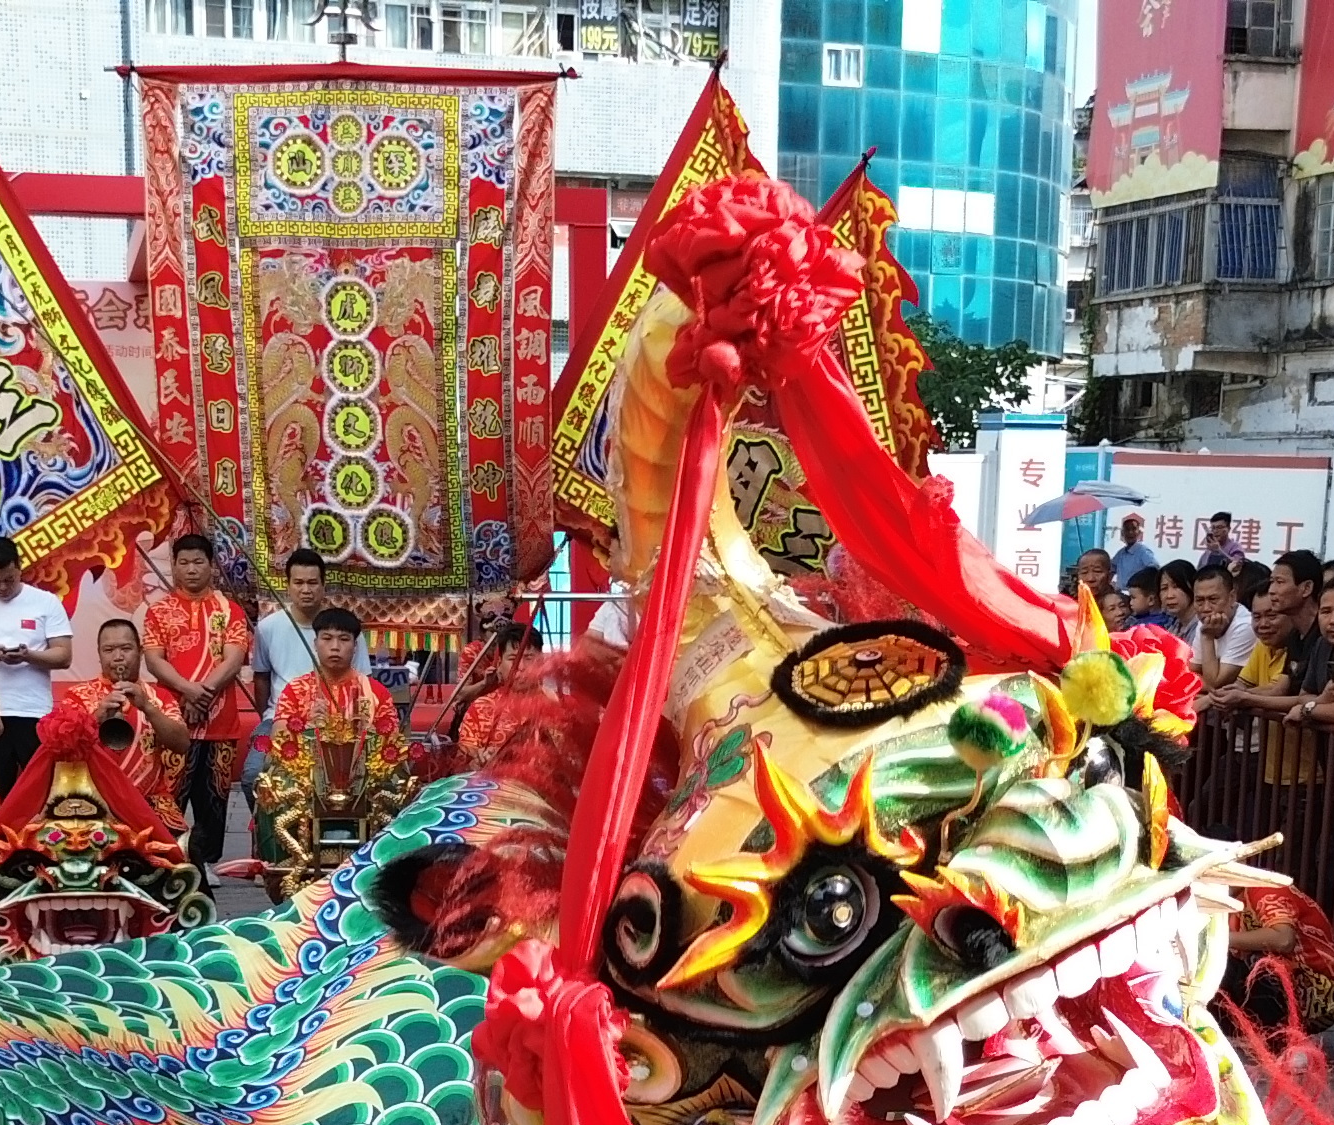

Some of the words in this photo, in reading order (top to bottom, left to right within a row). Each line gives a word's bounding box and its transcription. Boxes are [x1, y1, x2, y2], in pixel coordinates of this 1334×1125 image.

[581, 26, 618, 51] 199元
[684, 31, 719, 57] 79元
[155, 284, 194, 446] 國泰民安
[515, 285, 550, 451] 風調雨順
[1154, 514, 1304, 555] 特区建工
